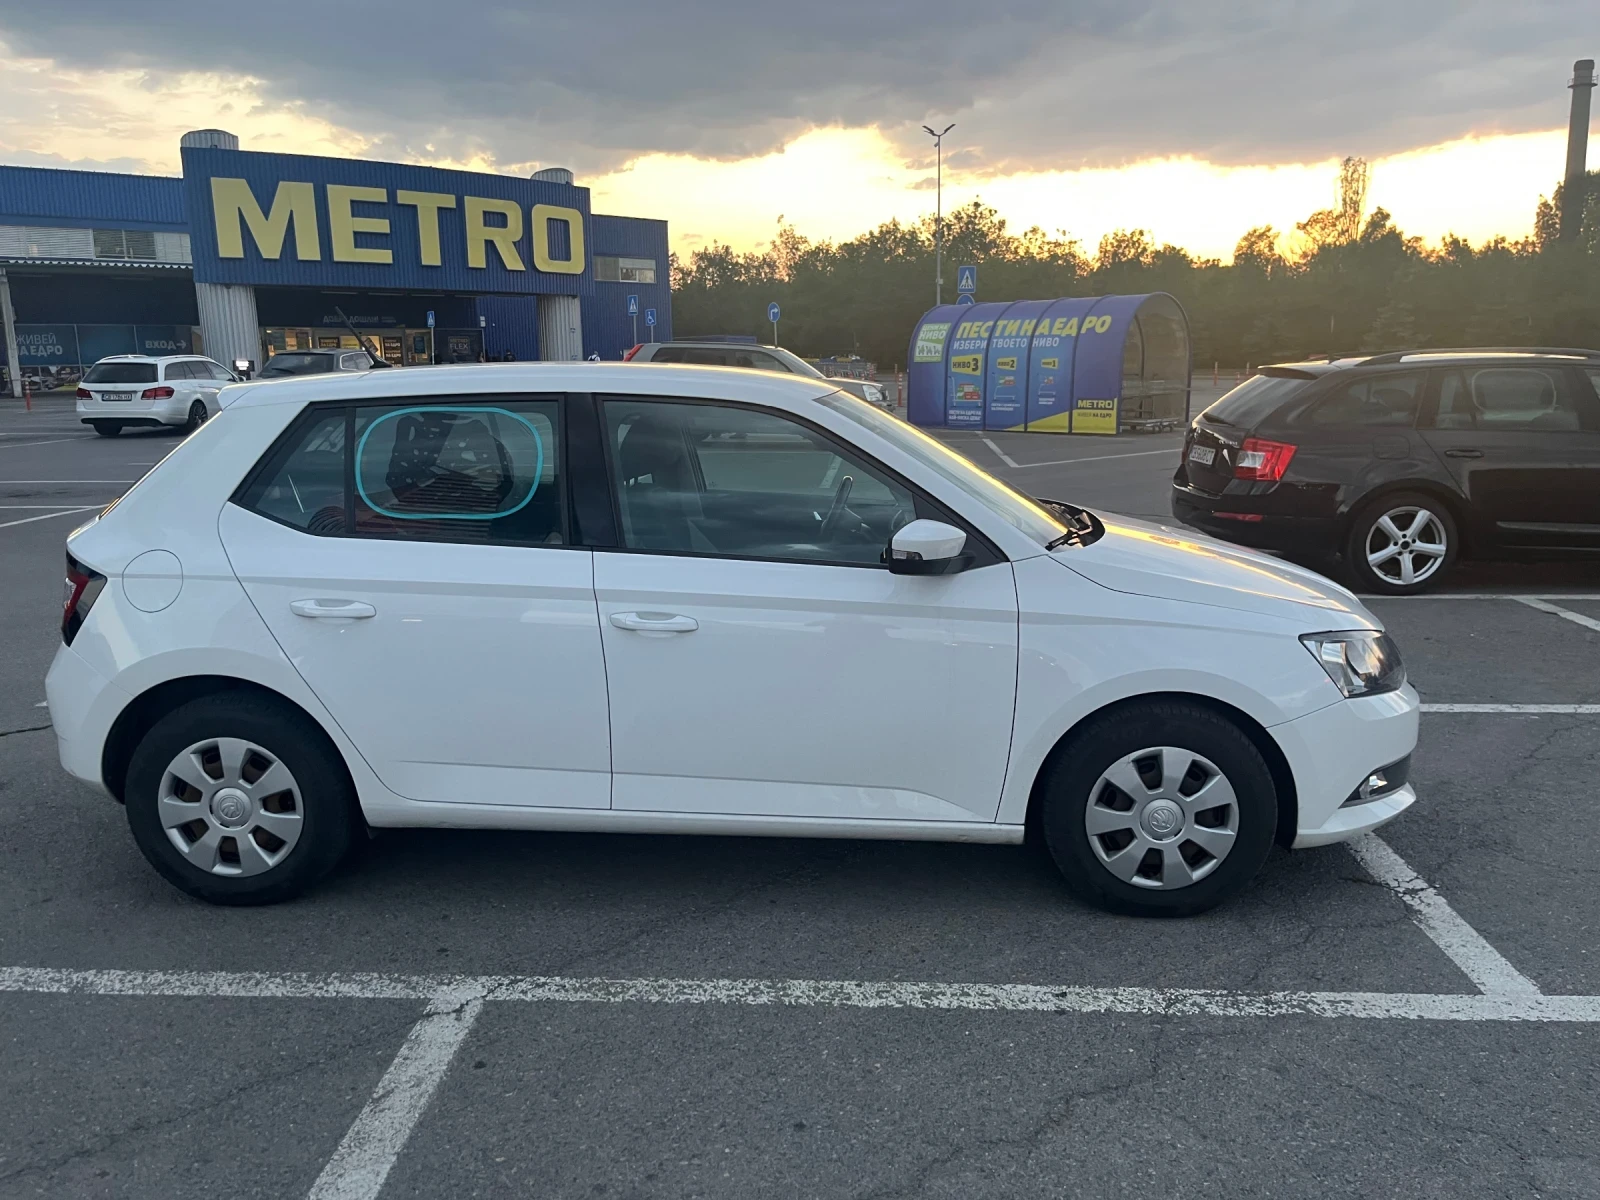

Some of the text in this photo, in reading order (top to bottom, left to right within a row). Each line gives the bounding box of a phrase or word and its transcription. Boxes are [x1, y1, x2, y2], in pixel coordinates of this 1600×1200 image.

[210, 177, 585, 274] METRO
[956, 315, 1112, 338] ПЕСТИ НА ЕДРО
[16, 332, 57, 345] ЖИВЕЙ
[918, 330, 946, 340] НИВО
[145, 340, 176, 350] ВХОД
[953, 337, 1060, 350] ИЗБЕРИ ТВОЕТО НИВО
[30, 345, 63, 357] ЕДРО
[952, 358, 979, 372] НИВО 3
[1010, 359, 1015, 368] 2
[1052, 359, 1056, 368] 1
[1077, 399, 1113, 409] METRO
